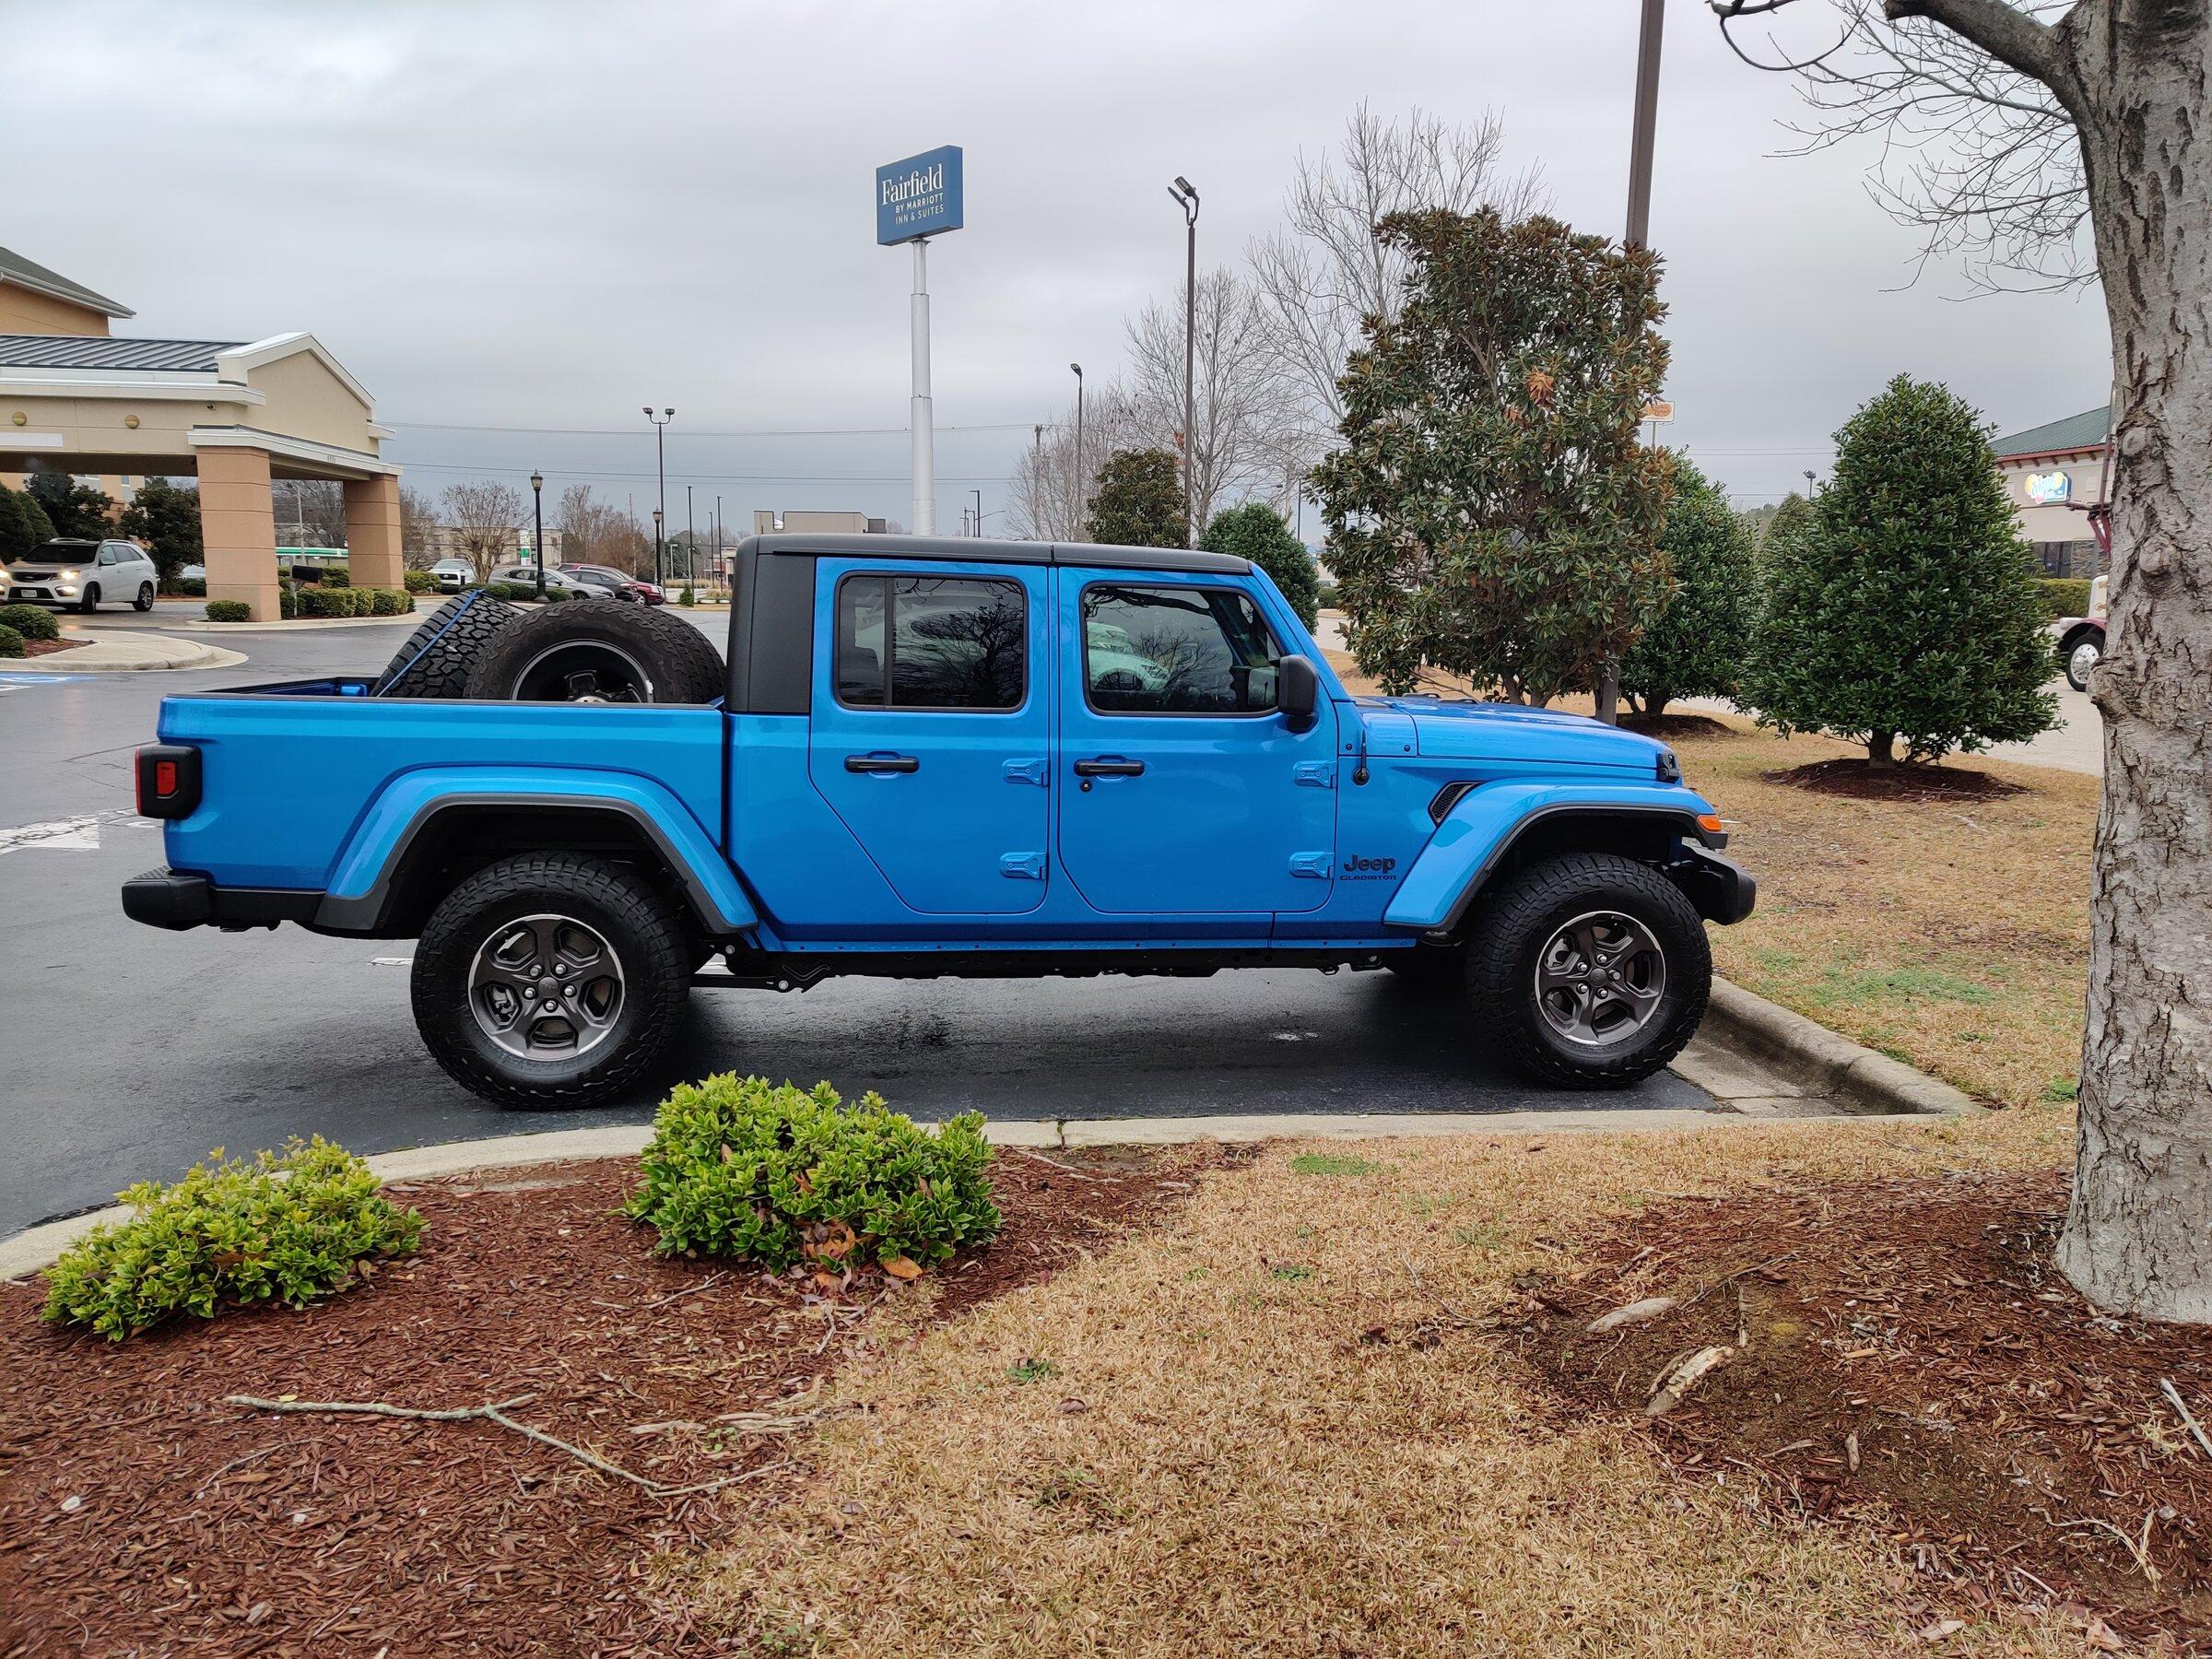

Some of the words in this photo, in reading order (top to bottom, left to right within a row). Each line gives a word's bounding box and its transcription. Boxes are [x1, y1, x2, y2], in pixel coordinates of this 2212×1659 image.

[882, 164, 943, 205] Fairfield
[895, 205, 903, 213] BY
[907, 193, 943, 210] MARRIOTT
[895, 216, 908, 225] INN
[911, 213, 915, 221] &
[918, 204, 944, 218] SUITES
[1343, 854, 1395, 874] Jeep
